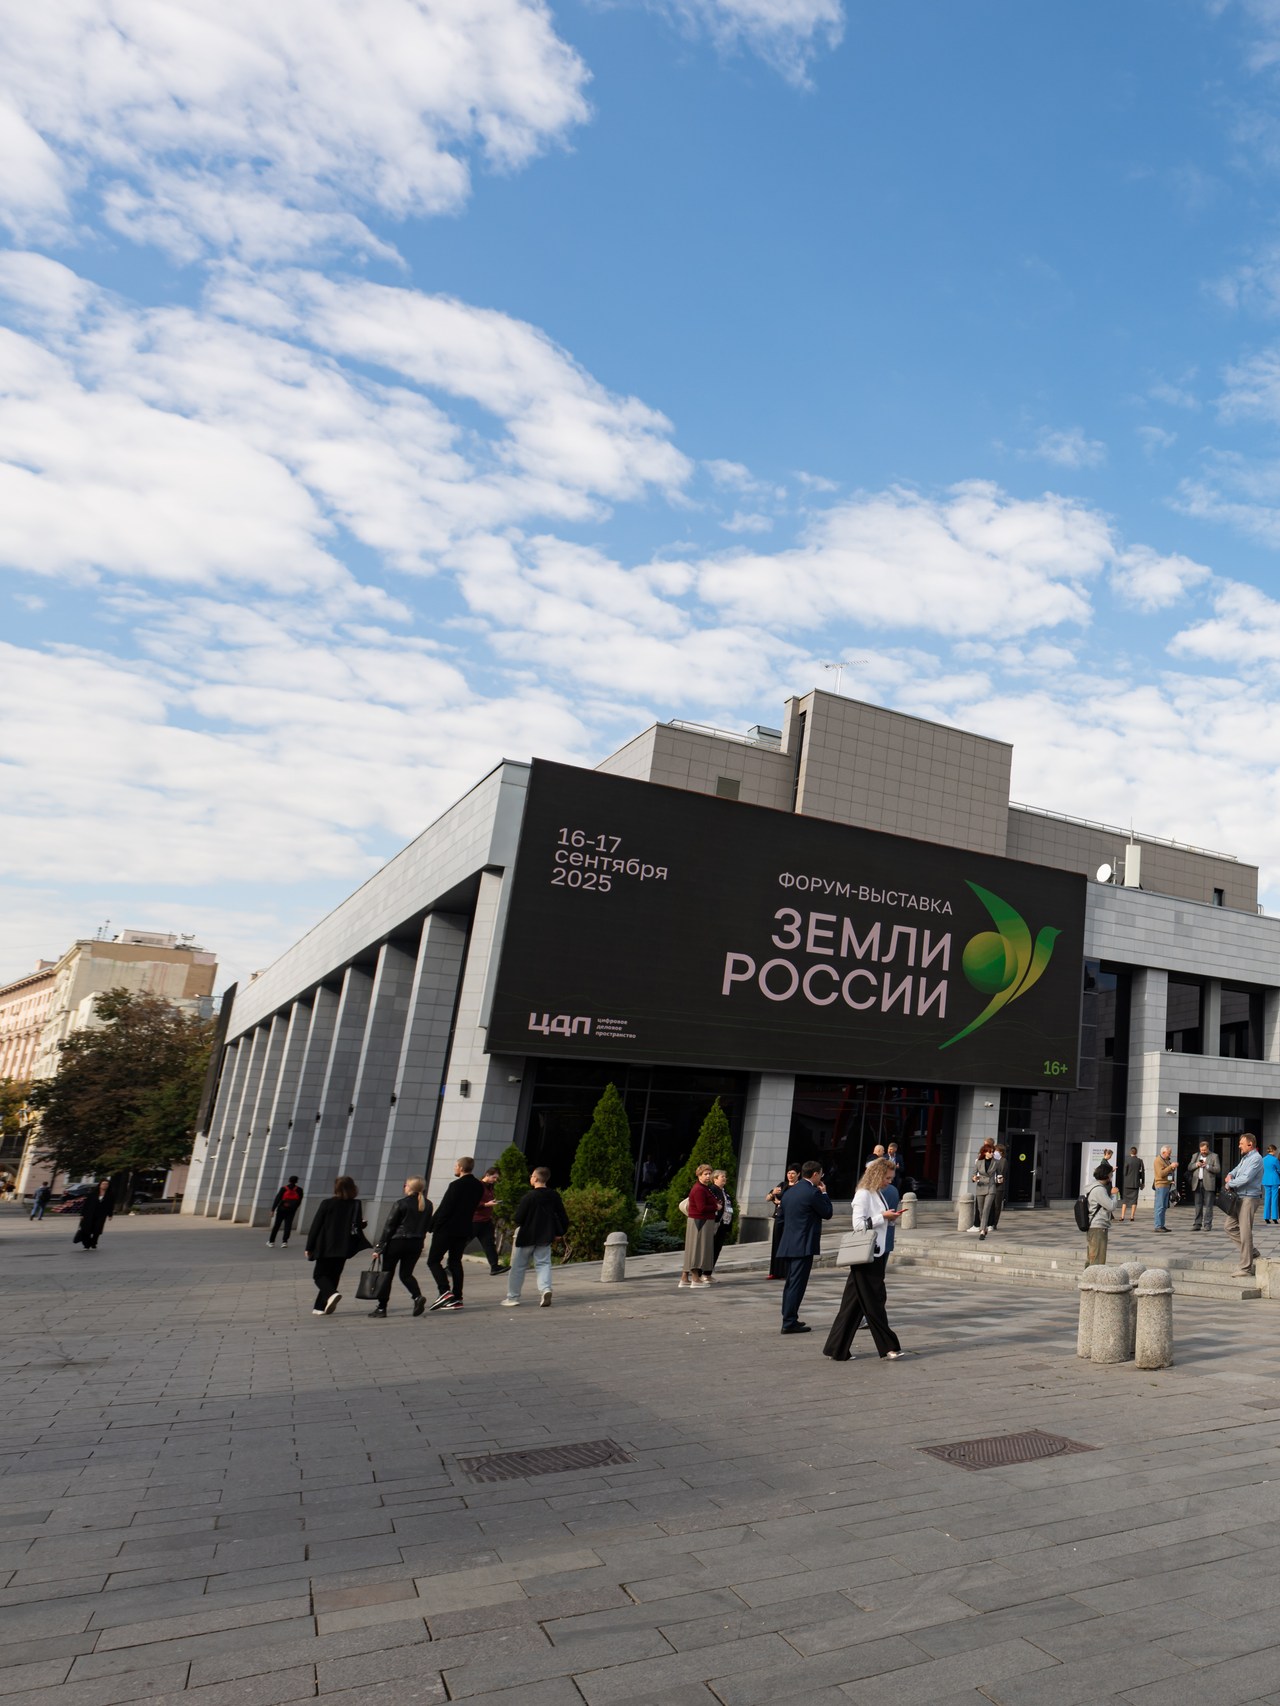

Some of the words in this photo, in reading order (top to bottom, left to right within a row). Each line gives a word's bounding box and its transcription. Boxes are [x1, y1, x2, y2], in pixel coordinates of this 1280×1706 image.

[557, 827, 622, 853] 16-17
[554, 849, 668, 881] сентября
[550, 867, 612, 892] 2025
[778, 871, 953, 916] ФОРУМ-ВЫСТАВКА
[771, 907, 952, 972] ЗЕМЛИ
[721, 951, 948, 1019] РОССИИ
[528, 1012, 592, 1037] ЦДП
[595, 1031, 637, 1039] пространство
[1043, 1060, 1069, 1076] 16+
